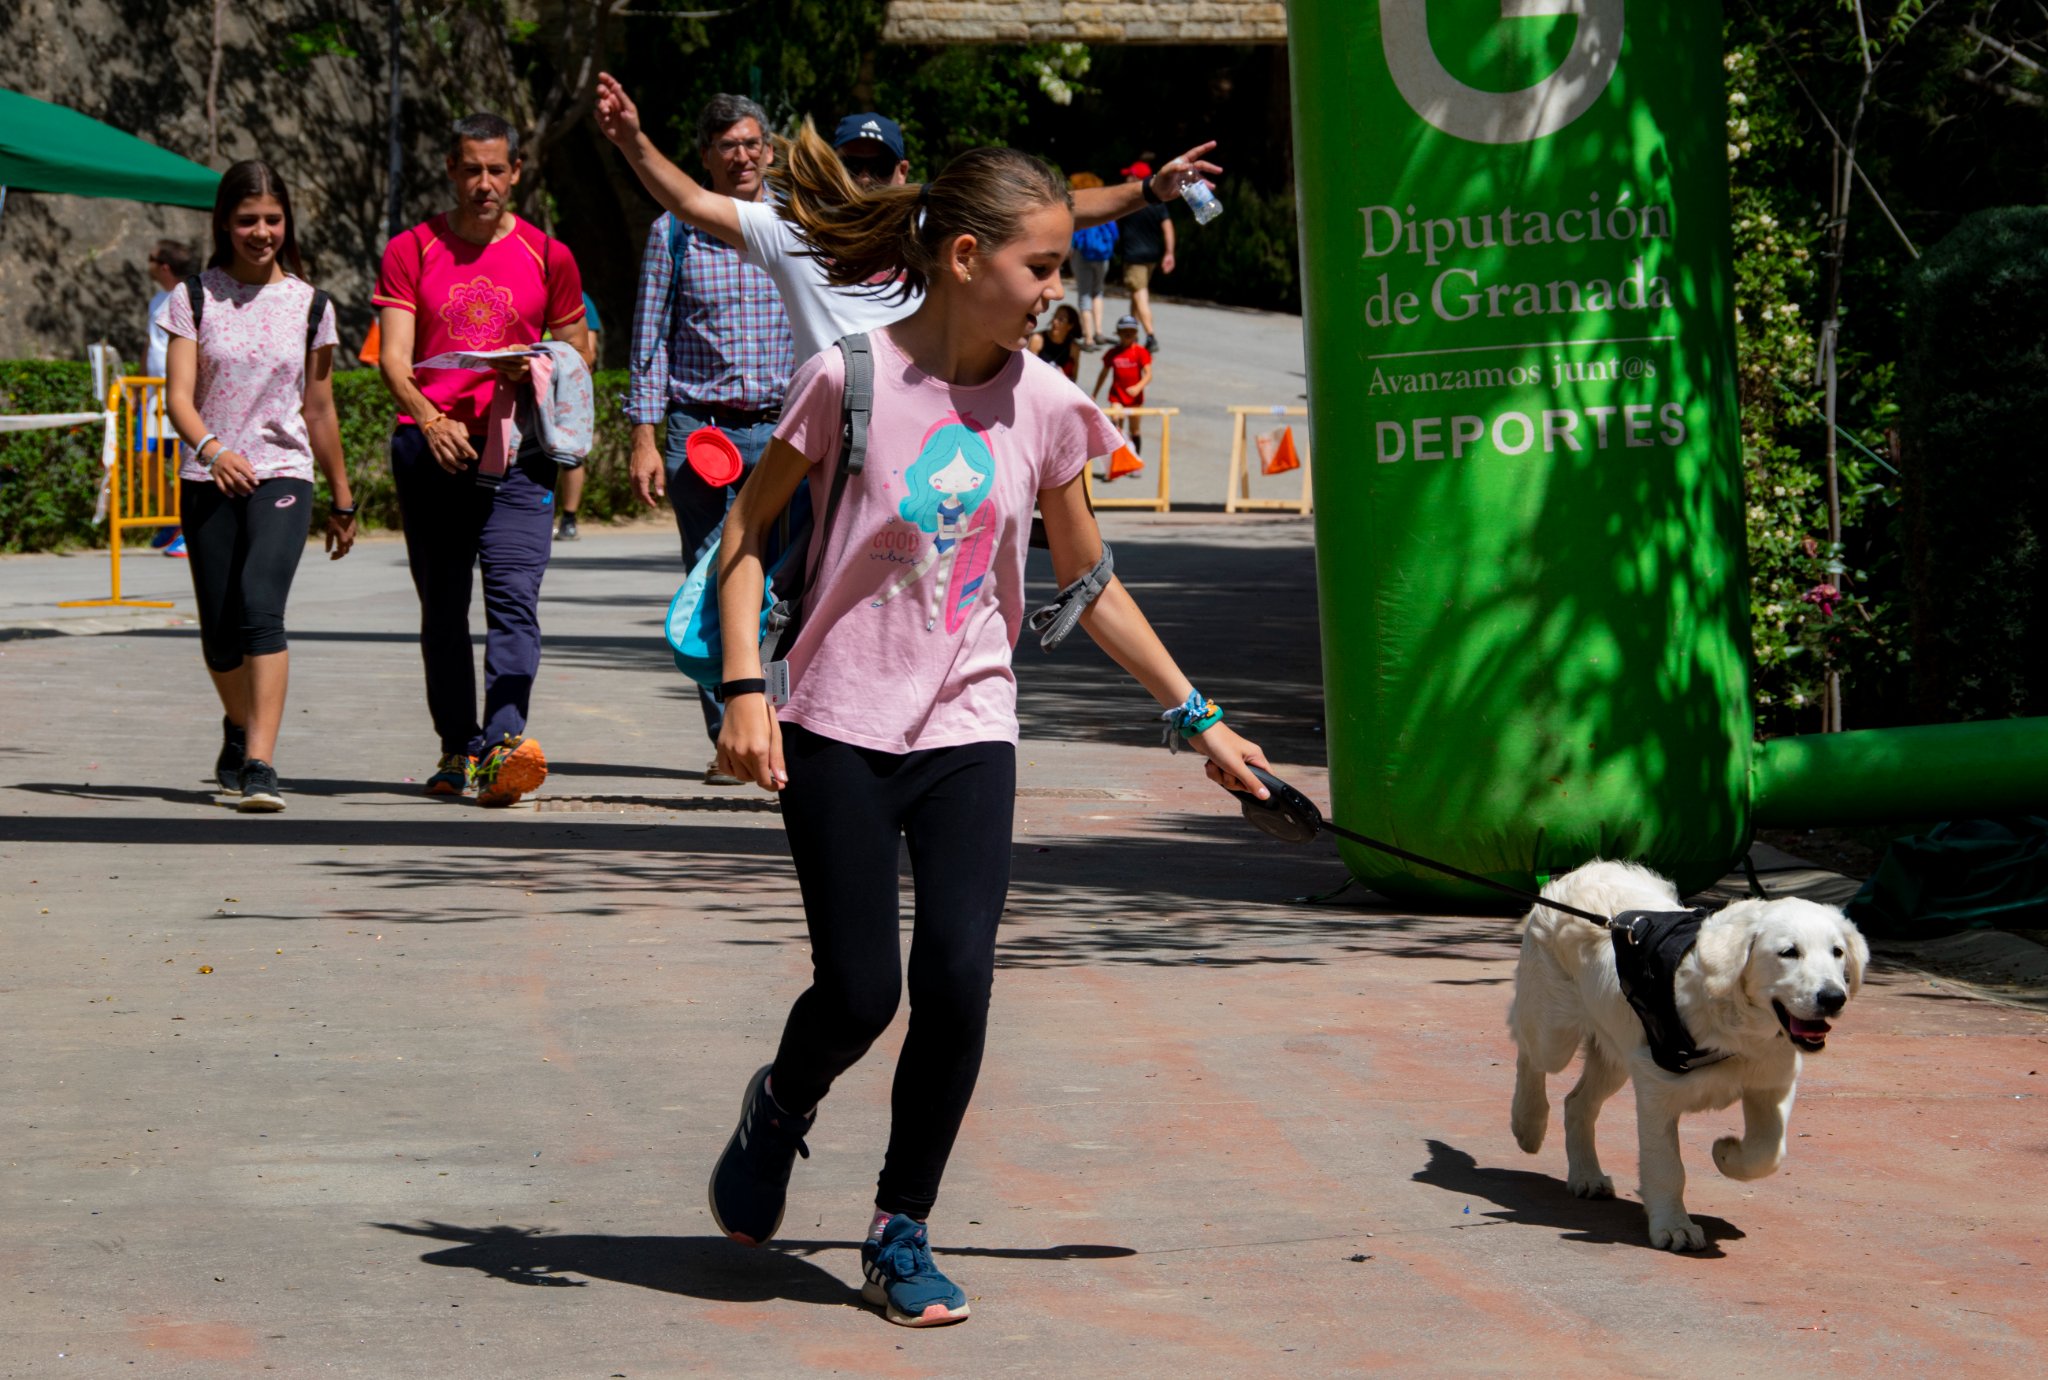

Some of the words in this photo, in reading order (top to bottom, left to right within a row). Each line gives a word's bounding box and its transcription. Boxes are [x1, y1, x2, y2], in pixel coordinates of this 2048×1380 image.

[1357, 191, 1670, 266] Diputación
[1365, 273, 1420, 328] de
[1431, 257, 1674, 322] Granada
[1367, 364, 1542, 396] Avanzamos
[1551, 354, 1657, 389] junt@s
[1375, 402, 1686, 464] DEPORTES
[873, 531, 920, 552] GOOD
